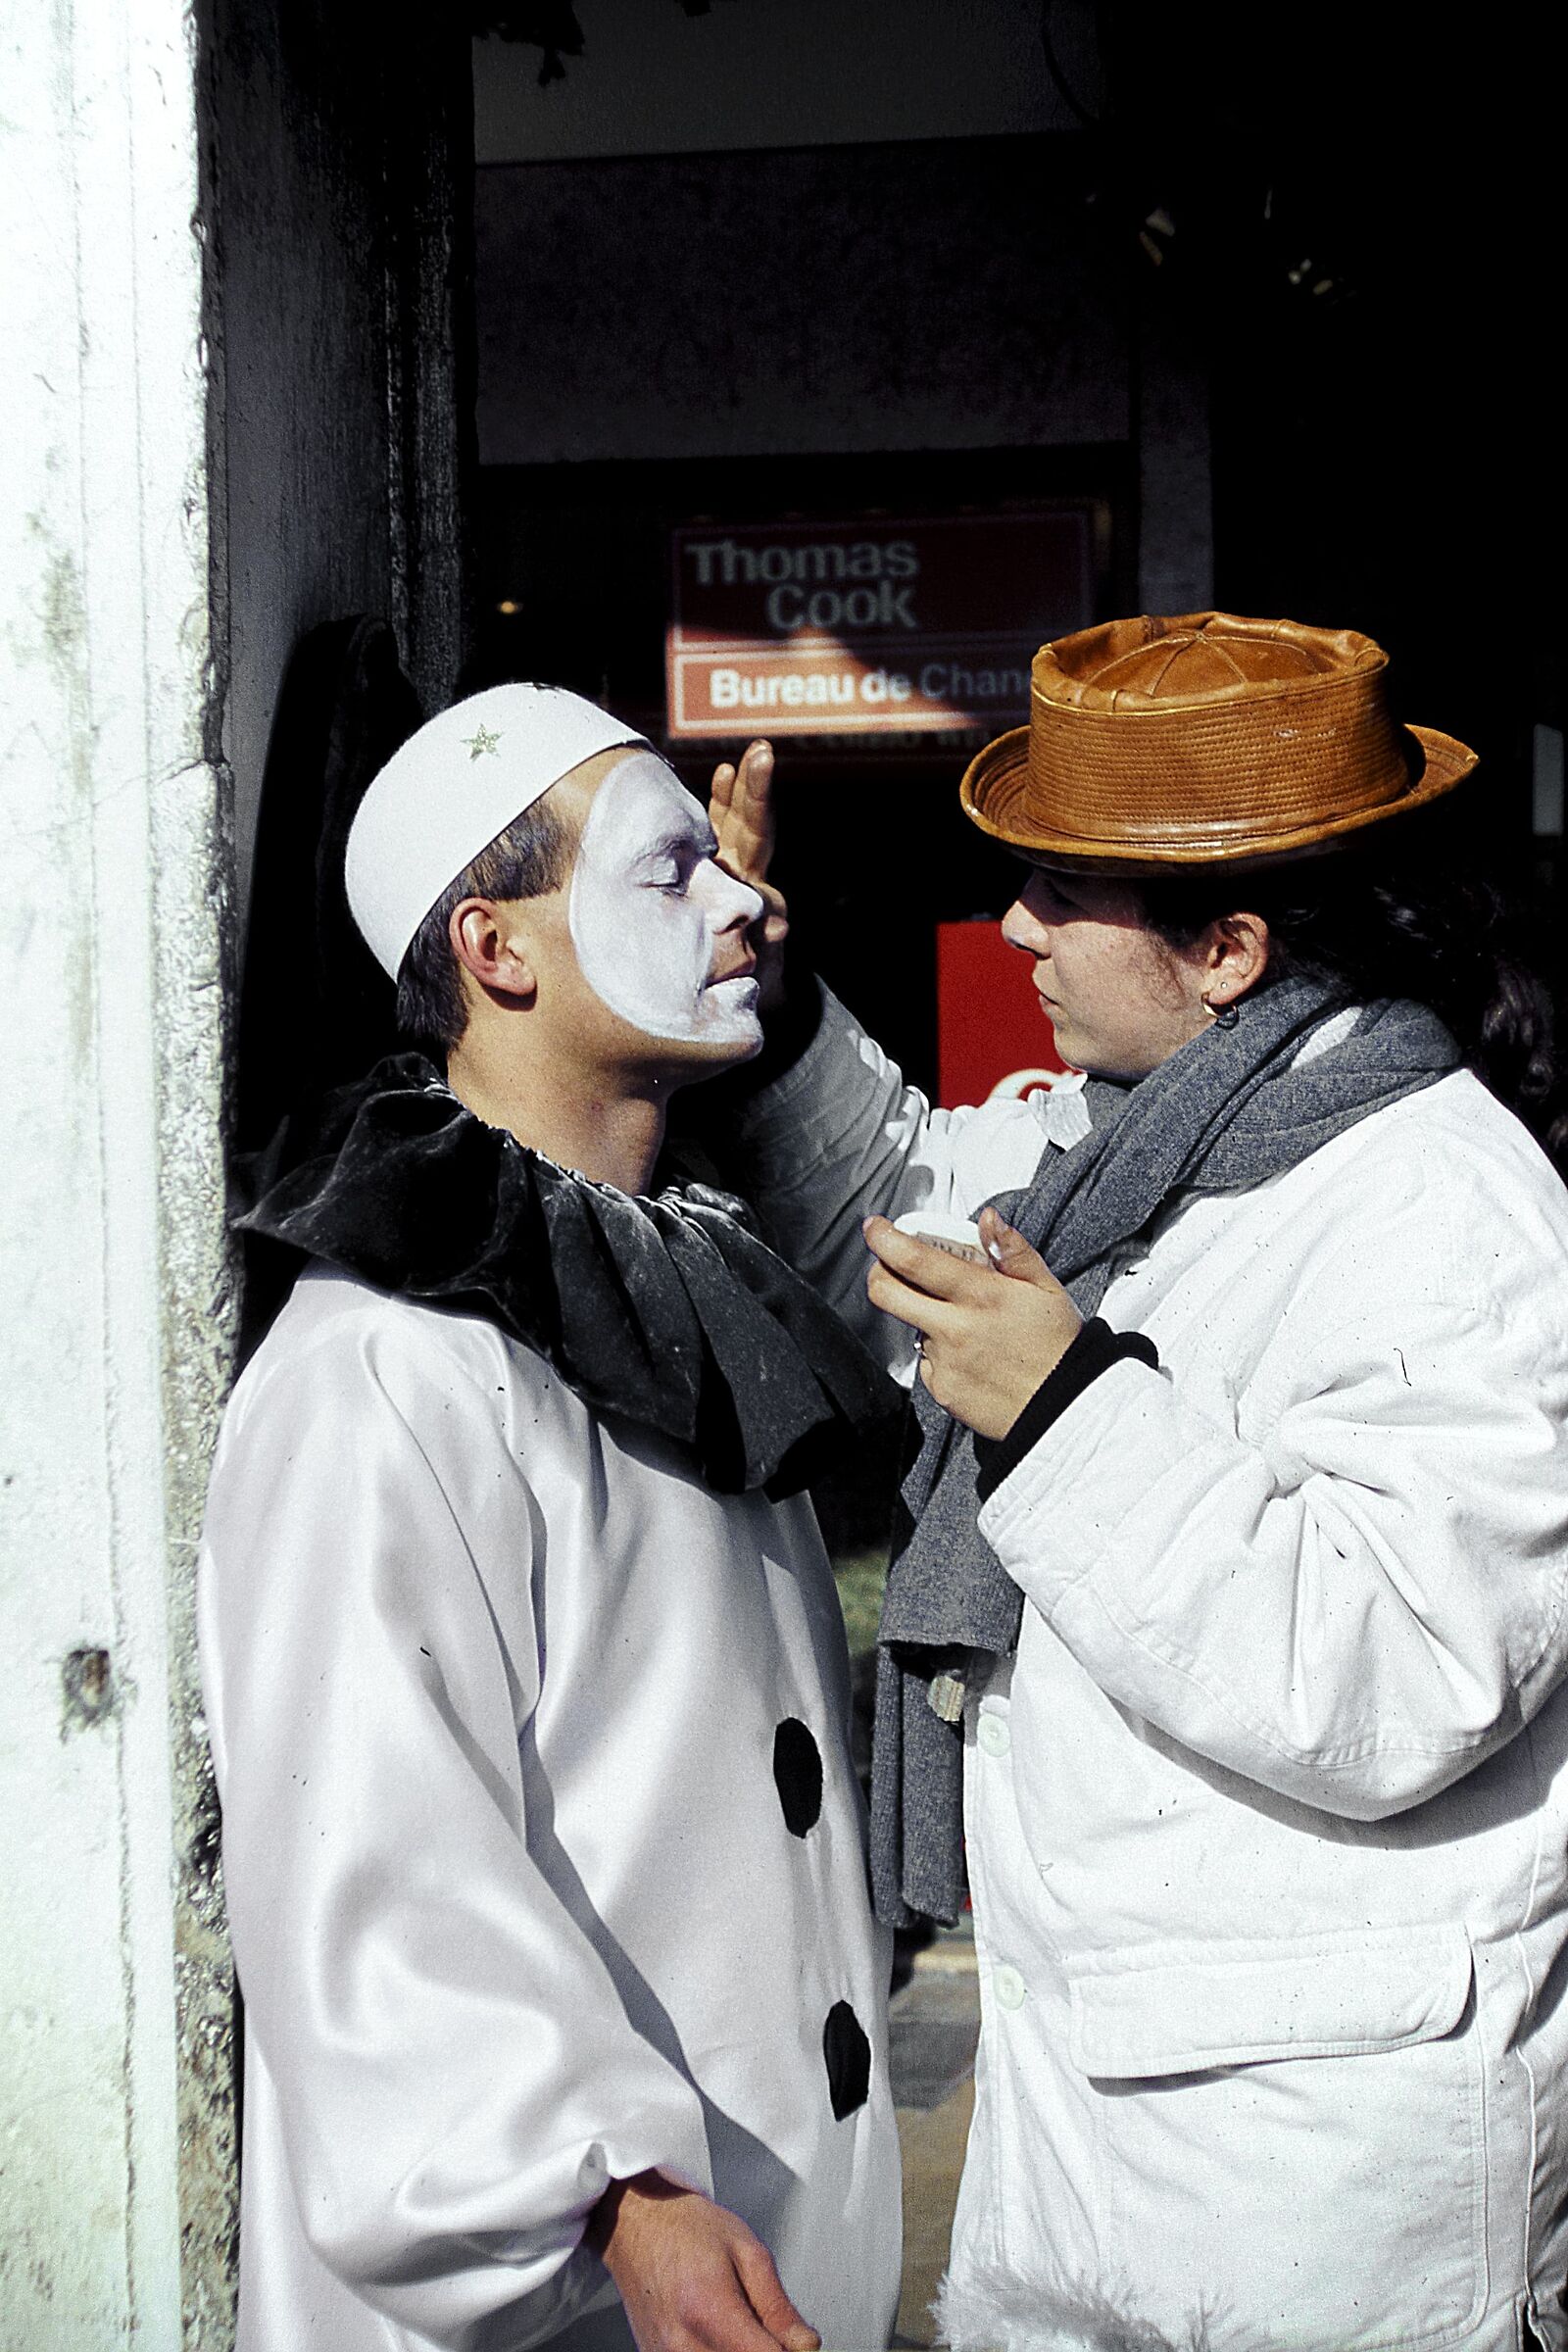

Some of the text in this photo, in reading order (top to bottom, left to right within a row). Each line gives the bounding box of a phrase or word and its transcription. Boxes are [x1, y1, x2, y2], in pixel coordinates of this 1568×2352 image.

[686, 540, 919, 585] Thomas
[765, 582, 918, 630] Cook
[710, 668, 854, 708] Bureau
[859, 667, 913, 703] de
